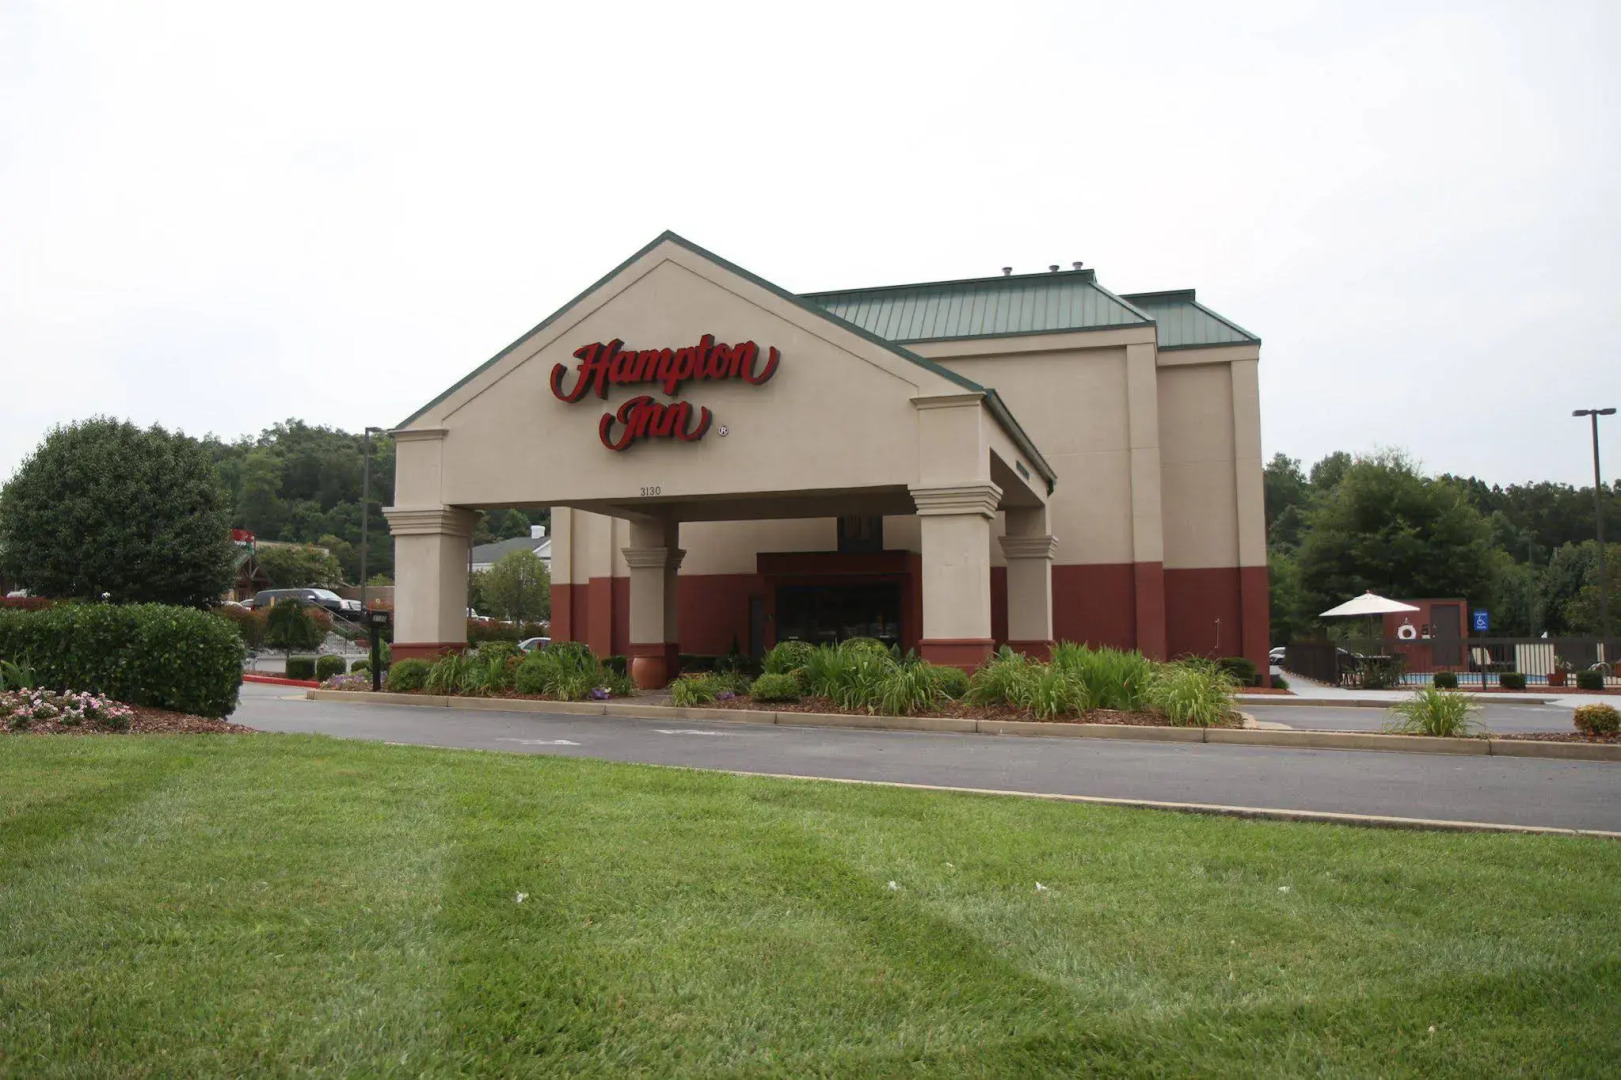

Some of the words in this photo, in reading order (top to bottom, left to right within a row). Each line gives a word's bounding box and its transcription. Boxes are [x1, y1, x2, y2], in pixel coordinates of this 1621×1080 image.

[551, 334, 780, 402] Hampton
[600, 396, 712, 450] Inn
[640, 486, 661, 497] 3130
